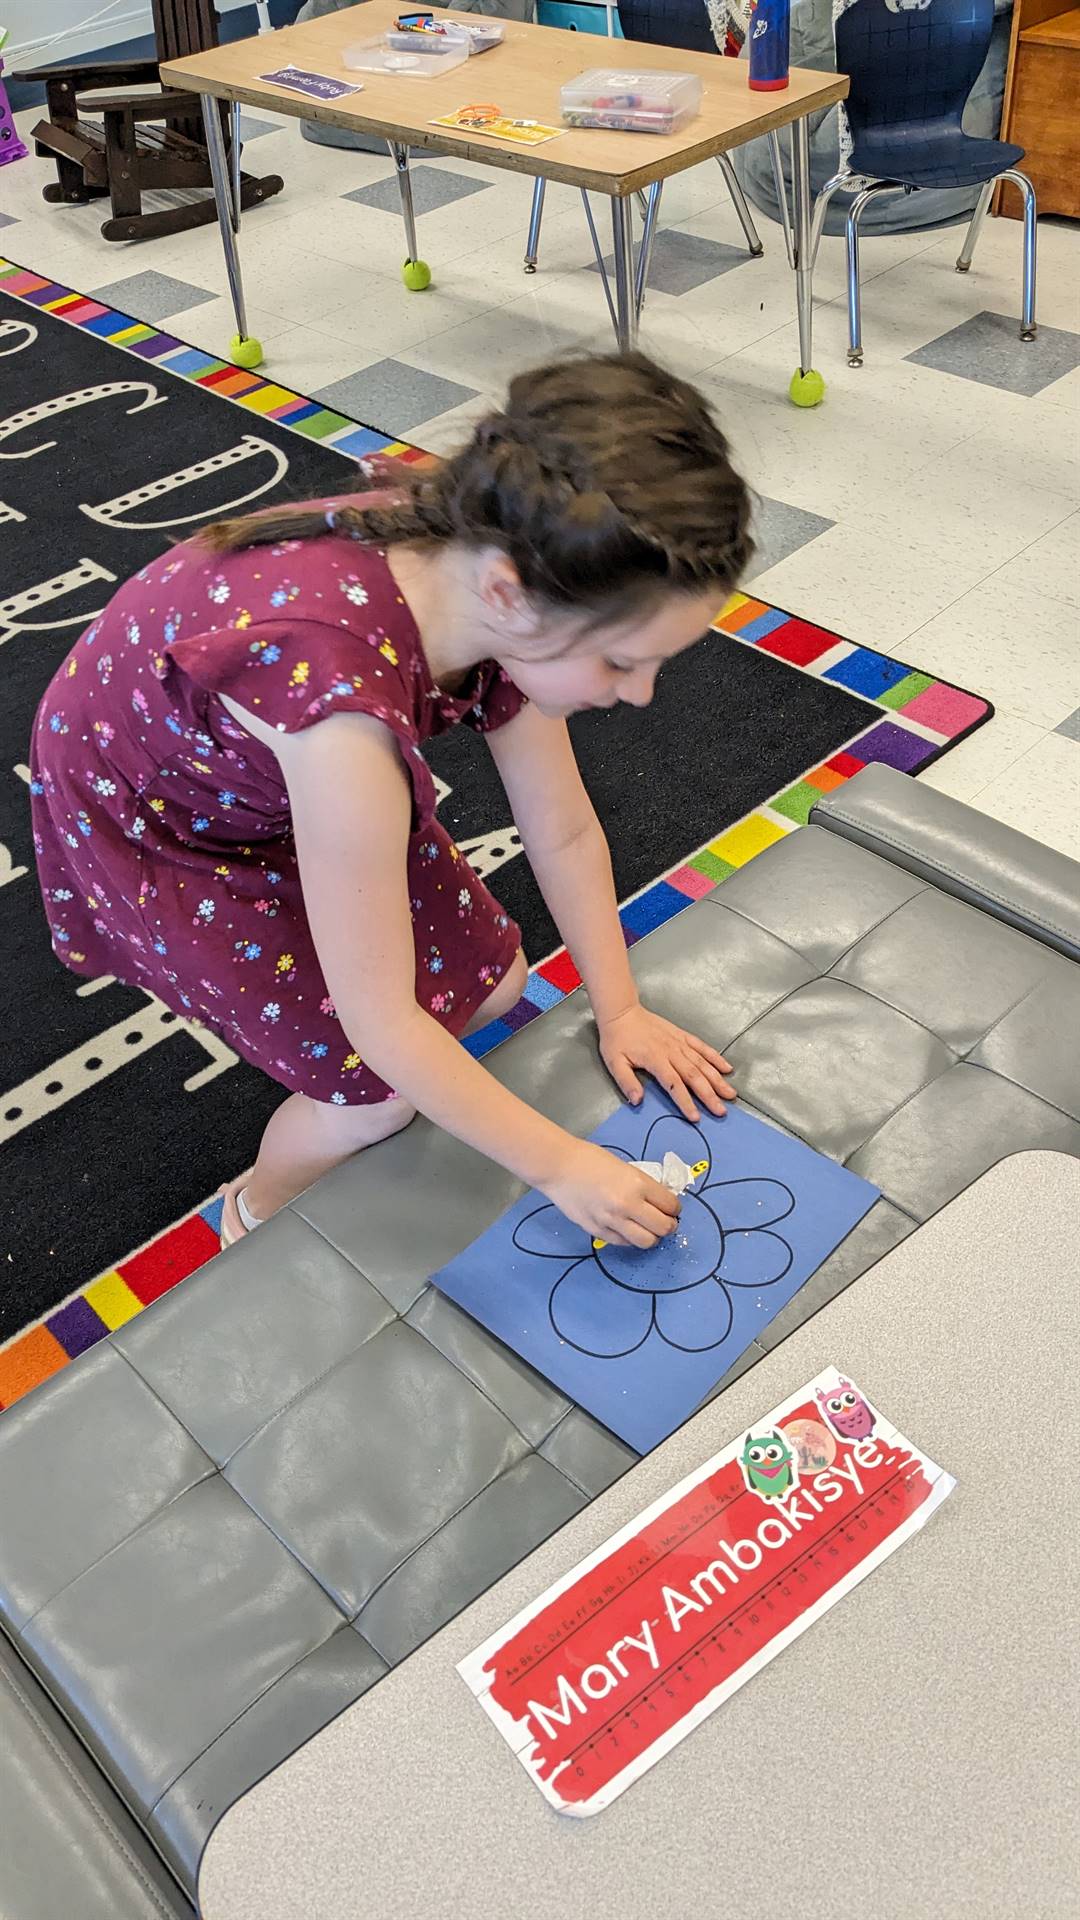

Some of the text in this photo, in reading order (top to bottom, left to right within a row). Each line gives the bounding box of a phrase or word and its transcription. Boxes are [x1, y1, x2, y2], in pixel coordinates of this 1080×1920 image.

[78, 434, 290, 530] D
[527, 1441, 883, 1740] Mary Ambakisye
